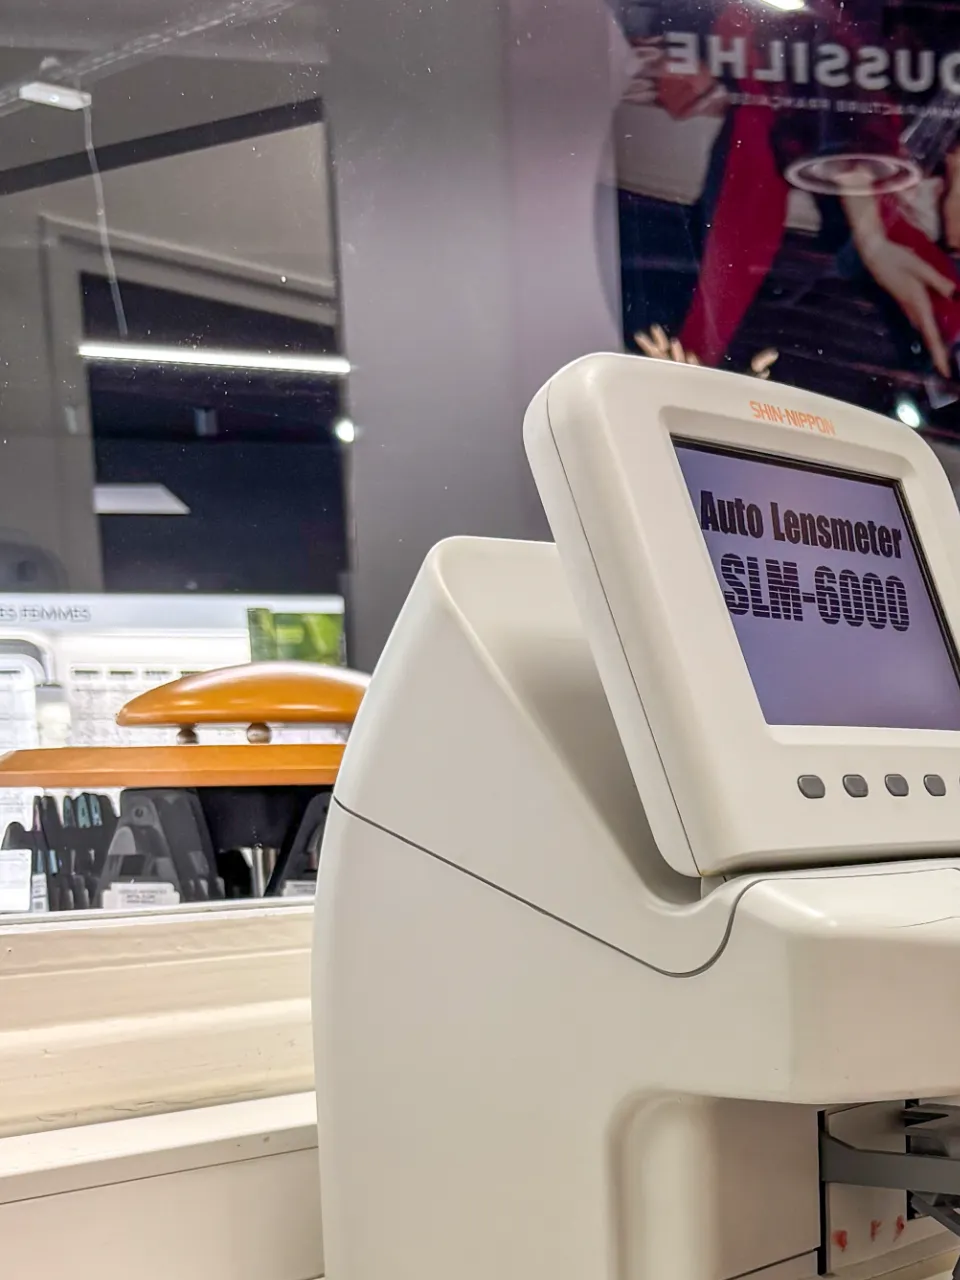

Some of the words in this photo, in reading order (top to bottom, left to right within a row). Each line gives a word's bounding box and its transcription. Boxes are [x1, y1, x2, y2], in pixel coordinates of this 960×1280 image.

[749, 400, 836, 435] SHIN-NIPPON
[700, 489, 764, 539] Auto
[770, 501, 902, 559] Lensmeter
[720, 553, 910, 632] SLM-6000
